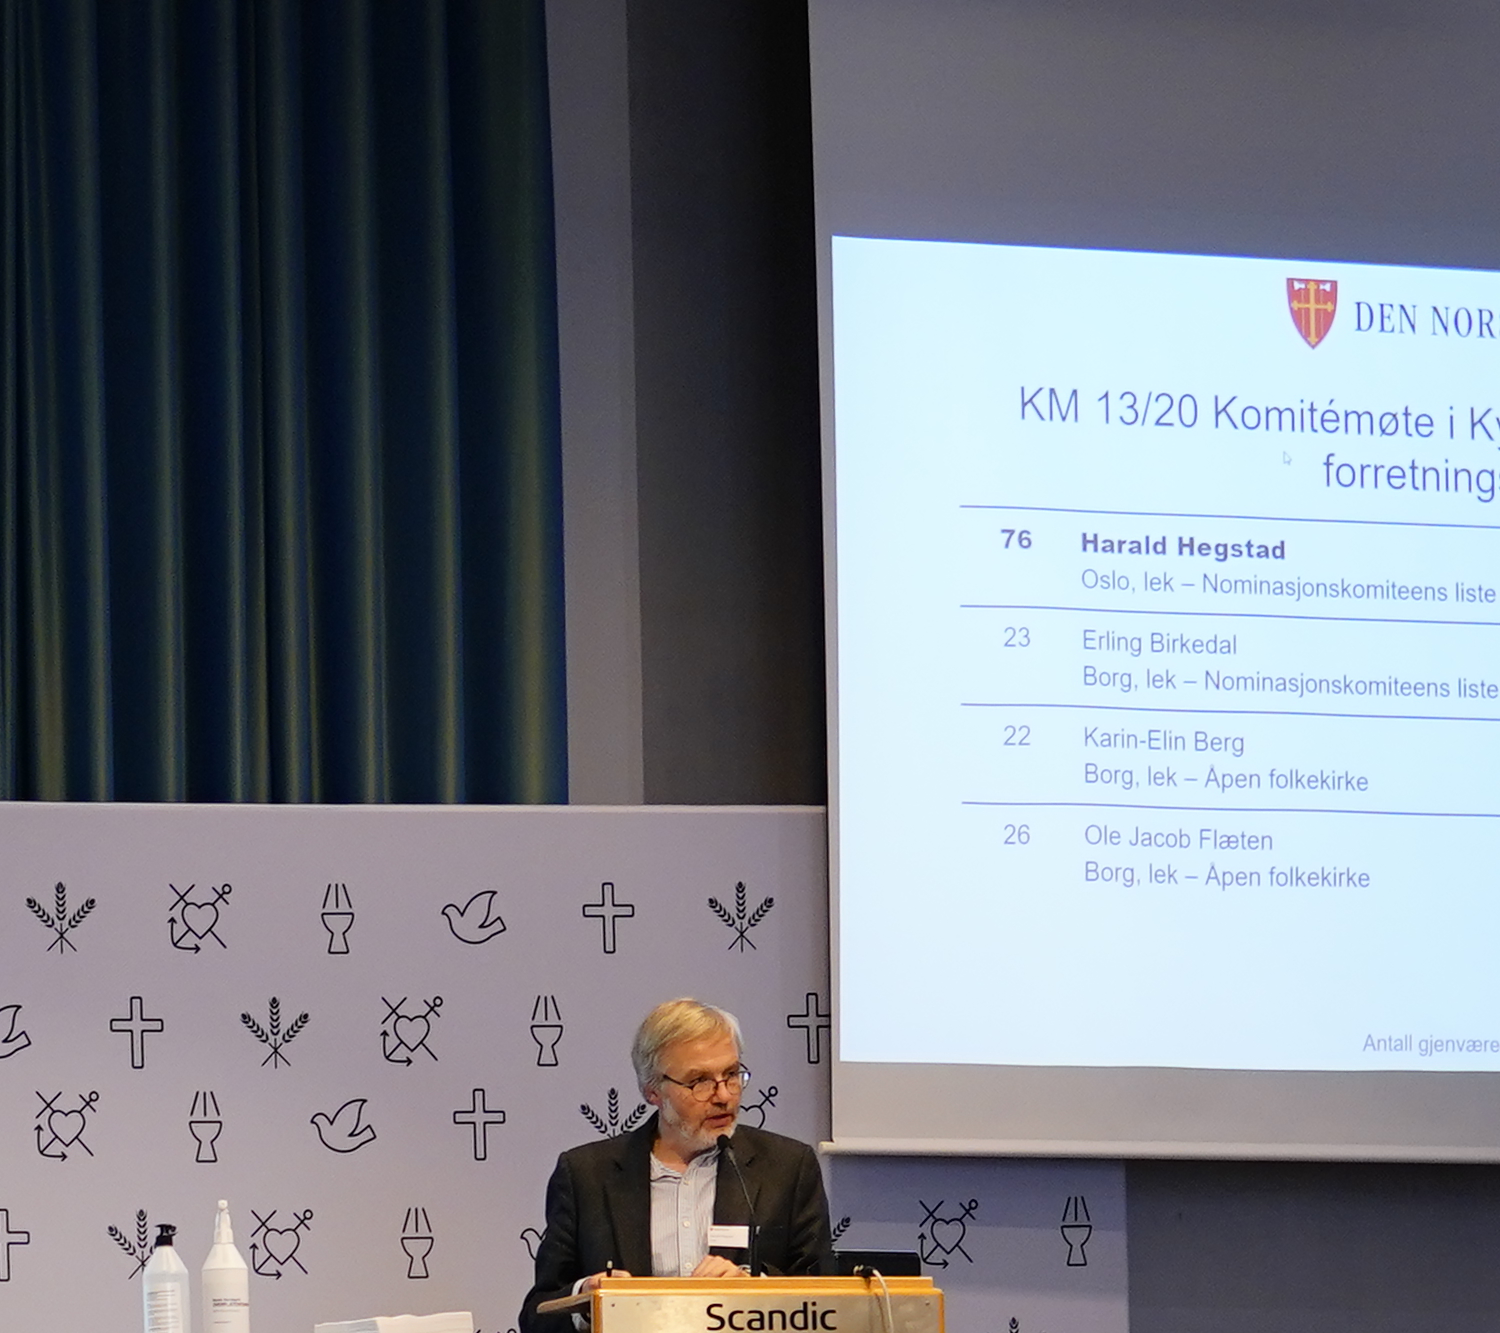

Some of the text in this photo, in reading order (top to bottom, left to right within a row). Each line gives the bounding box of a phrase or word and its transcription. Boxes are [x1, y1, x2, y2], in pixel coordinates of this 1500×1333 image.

[1354, 301, 1500, 342] DEN NOR
[1019, 385, 1079, 424] KM
[1096, 389, 1199, 430] 13/20
[1213, 394, 1435, 438] Komitémøte
[1448, 405, 1455, 440] i
[1322, 452, 1500, 503] forretning
[1000, 528, 1033, 551] 76
[1080, 531, 1286, 564] Harald Hegstad
[1080, 568, 1136, 595] Oslo,
[1144, 570, 1175, 593] lek
[1202, 572, 1449, 604] Nominasjonskomiteens
[1455, 581, 1497, 604] liste
[1003, 626, 1031, 648] 23
[1082, 628, 1237, 657] Erling Birkedal
[1083, 664, 1139, 693] Borg,
[1146, 667, 1177, 690] lek
[1204, 669, 1451, 699] Nominasjonskomiteens
[1457, 677, 1500, 700] liste
[1002, 724, 1031, 747] 22
[1084, 726, 1245, 759] Karin-Elin Berg
[1084, 762, 1140, 791] Borg,
[1147, 764, 1178, 788] lek
[1204, 763, 1262, 794] Åpen
[1267, 767, 1369, 792] folkekirke
[1003, 823, 1031, 846] 26
[1084, 823, 1274, 851] Ole Jacob Flæten
[1084, 860, 1141, 889] Borg,
[1148, 862, 1179, 885] lek
[1204, 861, 1261, 892] Åpen
[1267, 865, 1371, 889] folkekirke
[1362, 1033, 1413, 1052] Antall
[705, 1301, 838, 1333] Scandic
